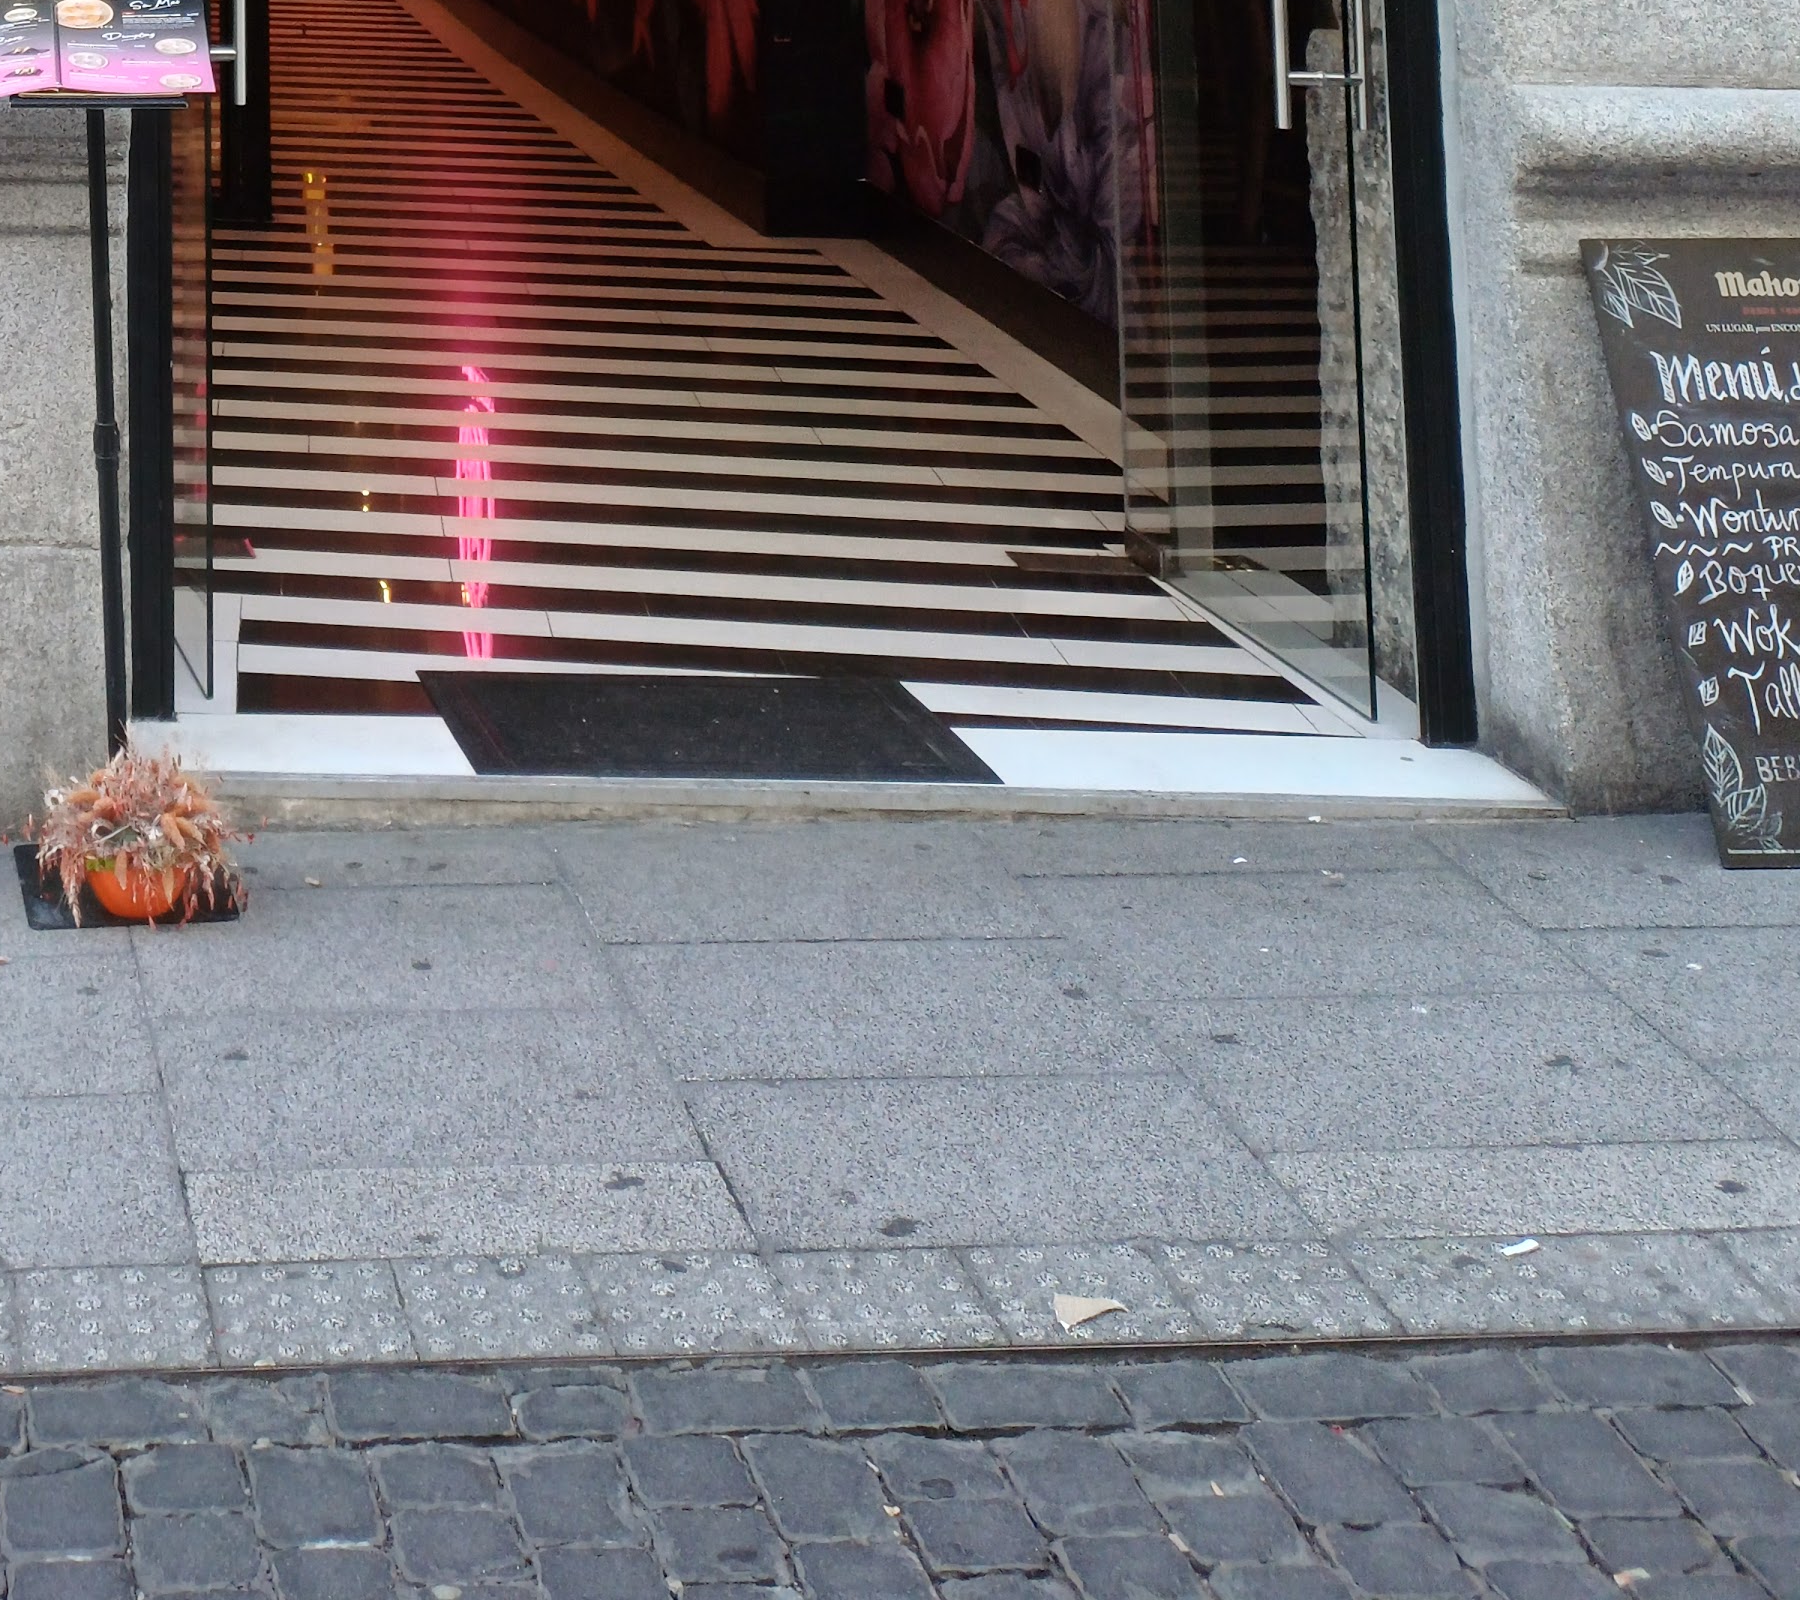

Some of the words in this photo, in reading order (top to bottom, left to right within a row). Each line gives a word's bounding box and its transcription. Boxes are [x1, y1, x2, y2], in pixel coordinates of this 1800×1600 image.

[1714, 270, 1800, 297] Maho
[1650, 346, 1783, 404] Menú
[1662, 455, 1800, 500] Tempura
[1698, 559, 1800, 605] Boque
[1713, 603, 1800, 660] Wok
[1755, 755, 1800, 783] BEB
